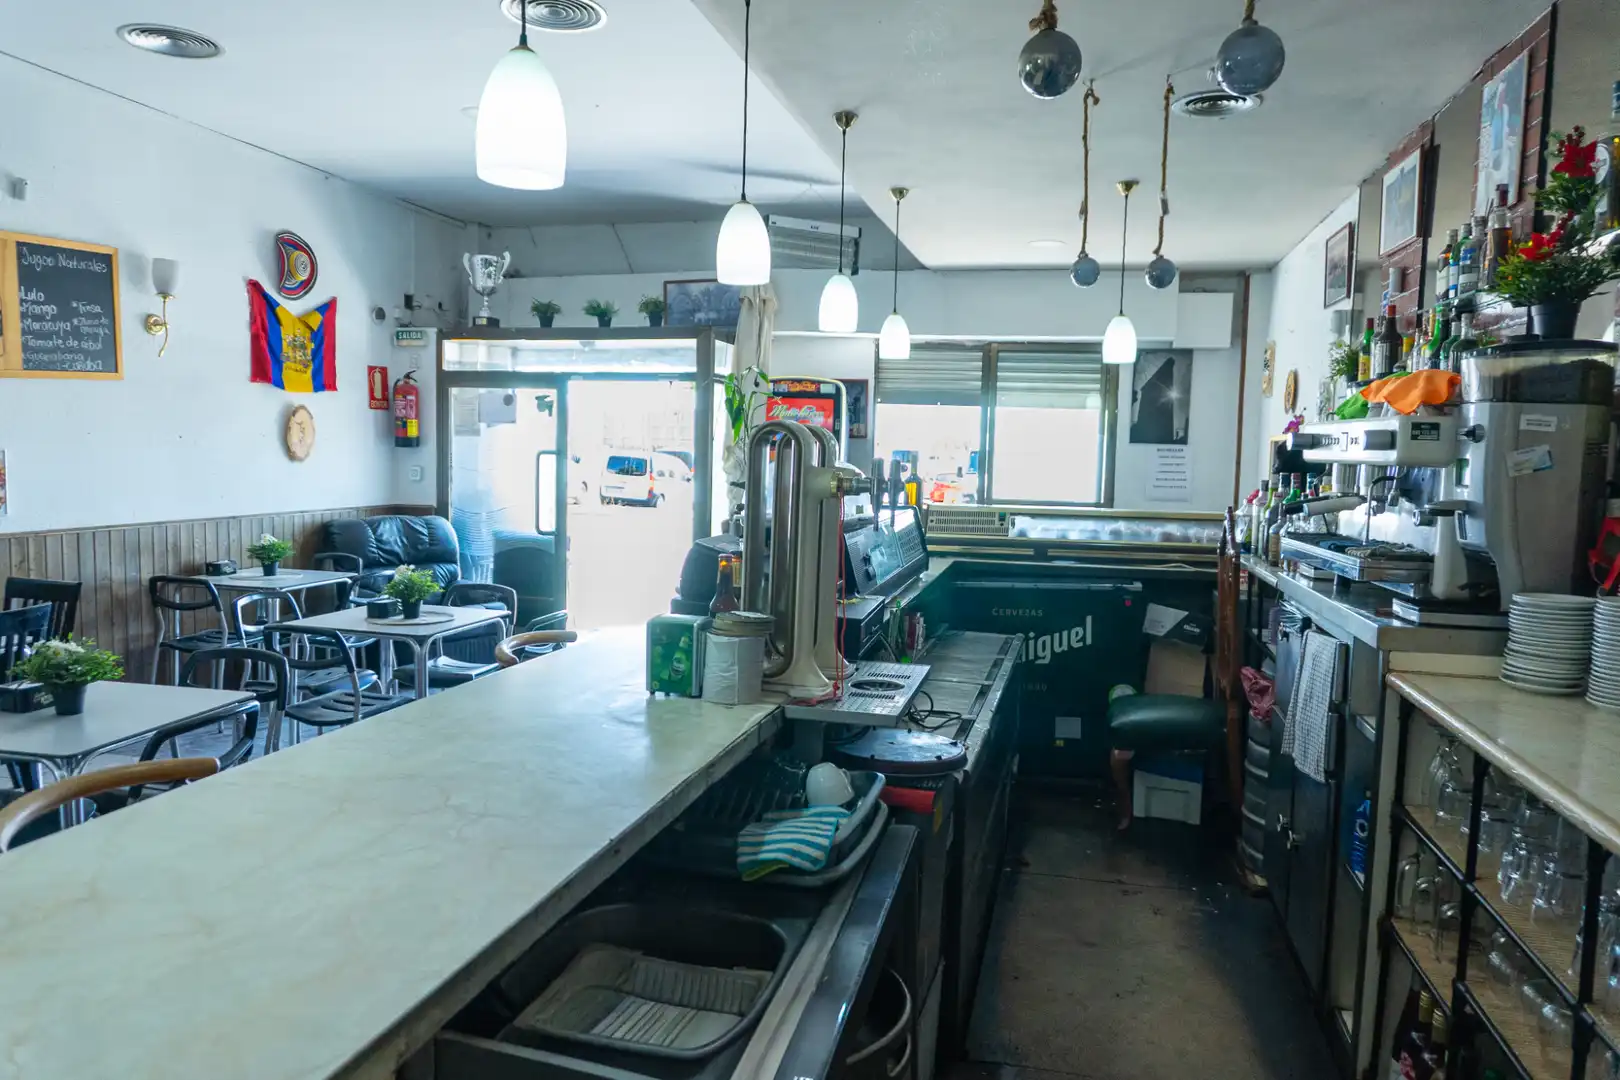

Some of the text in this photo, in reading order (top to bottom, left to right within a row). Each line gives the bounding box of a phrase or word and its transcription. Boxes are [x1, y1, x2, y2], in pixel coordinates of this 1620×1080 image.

[58, 252, 107, 272] Naturales
[21, 286, 45, 302] Lulo
[23, 302, 58, 319] Mango
[24, 335, 65, 349] Tomate
[66, 335, 79, 349] de
[398, 331, 422, 339] SALIDA
[991, 607, 1044, 617] CERVEZAS
